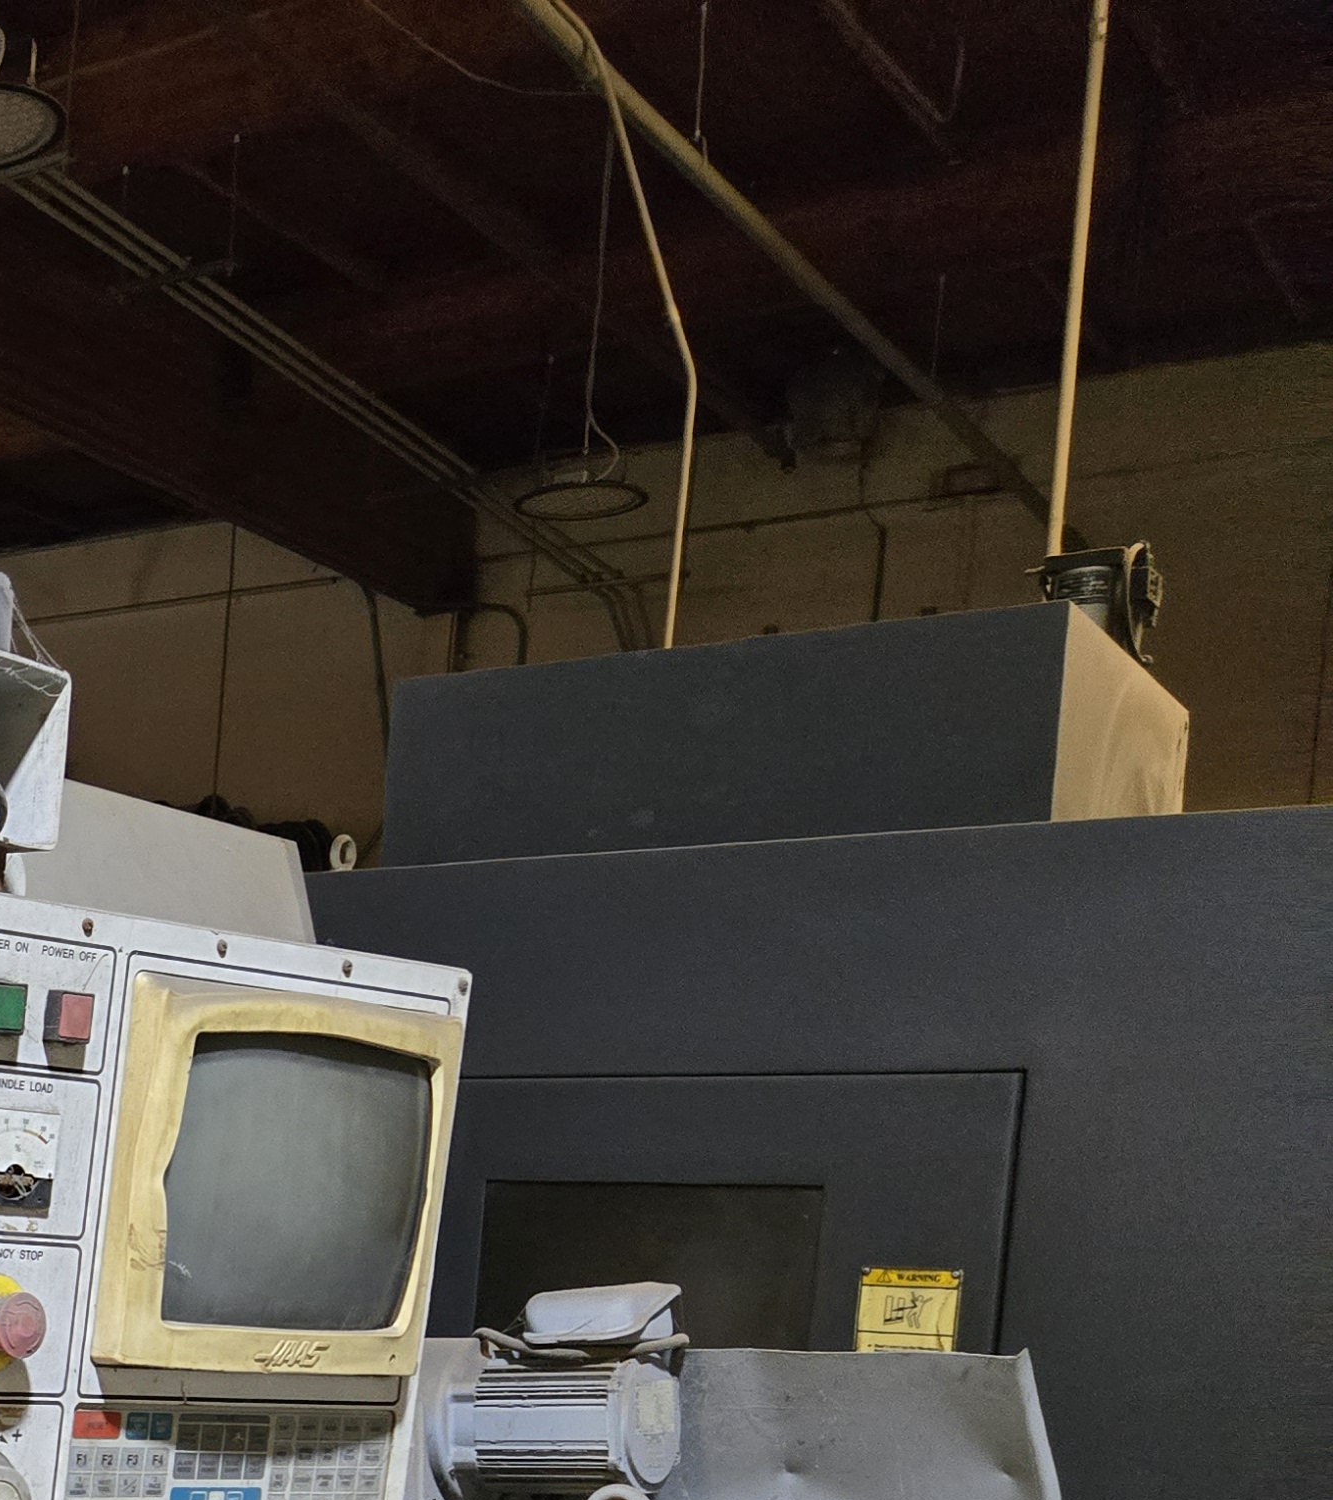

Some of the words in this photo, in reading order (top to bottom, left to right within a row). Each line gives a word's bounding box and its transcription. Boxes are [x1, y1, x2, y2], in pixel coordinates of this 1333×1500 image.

[15, 941, 29, 953] ON
[41, 945, 74, 959] POWER
[78, 951, 97, 962] OFF
[29, 1081, 53, 1093] LOAD
[19, 1249, 43, 1261] STOP
[897, 1274, 941, 1282] WARNING
[254, 1339, 330, 1368] HAAS
[76, 1454, 87, 1465] F1
[101, 1455, 113, 1466] F2
[126, 1455, 138, 1465] F3
[152, 1455, 163, 1466] F4
